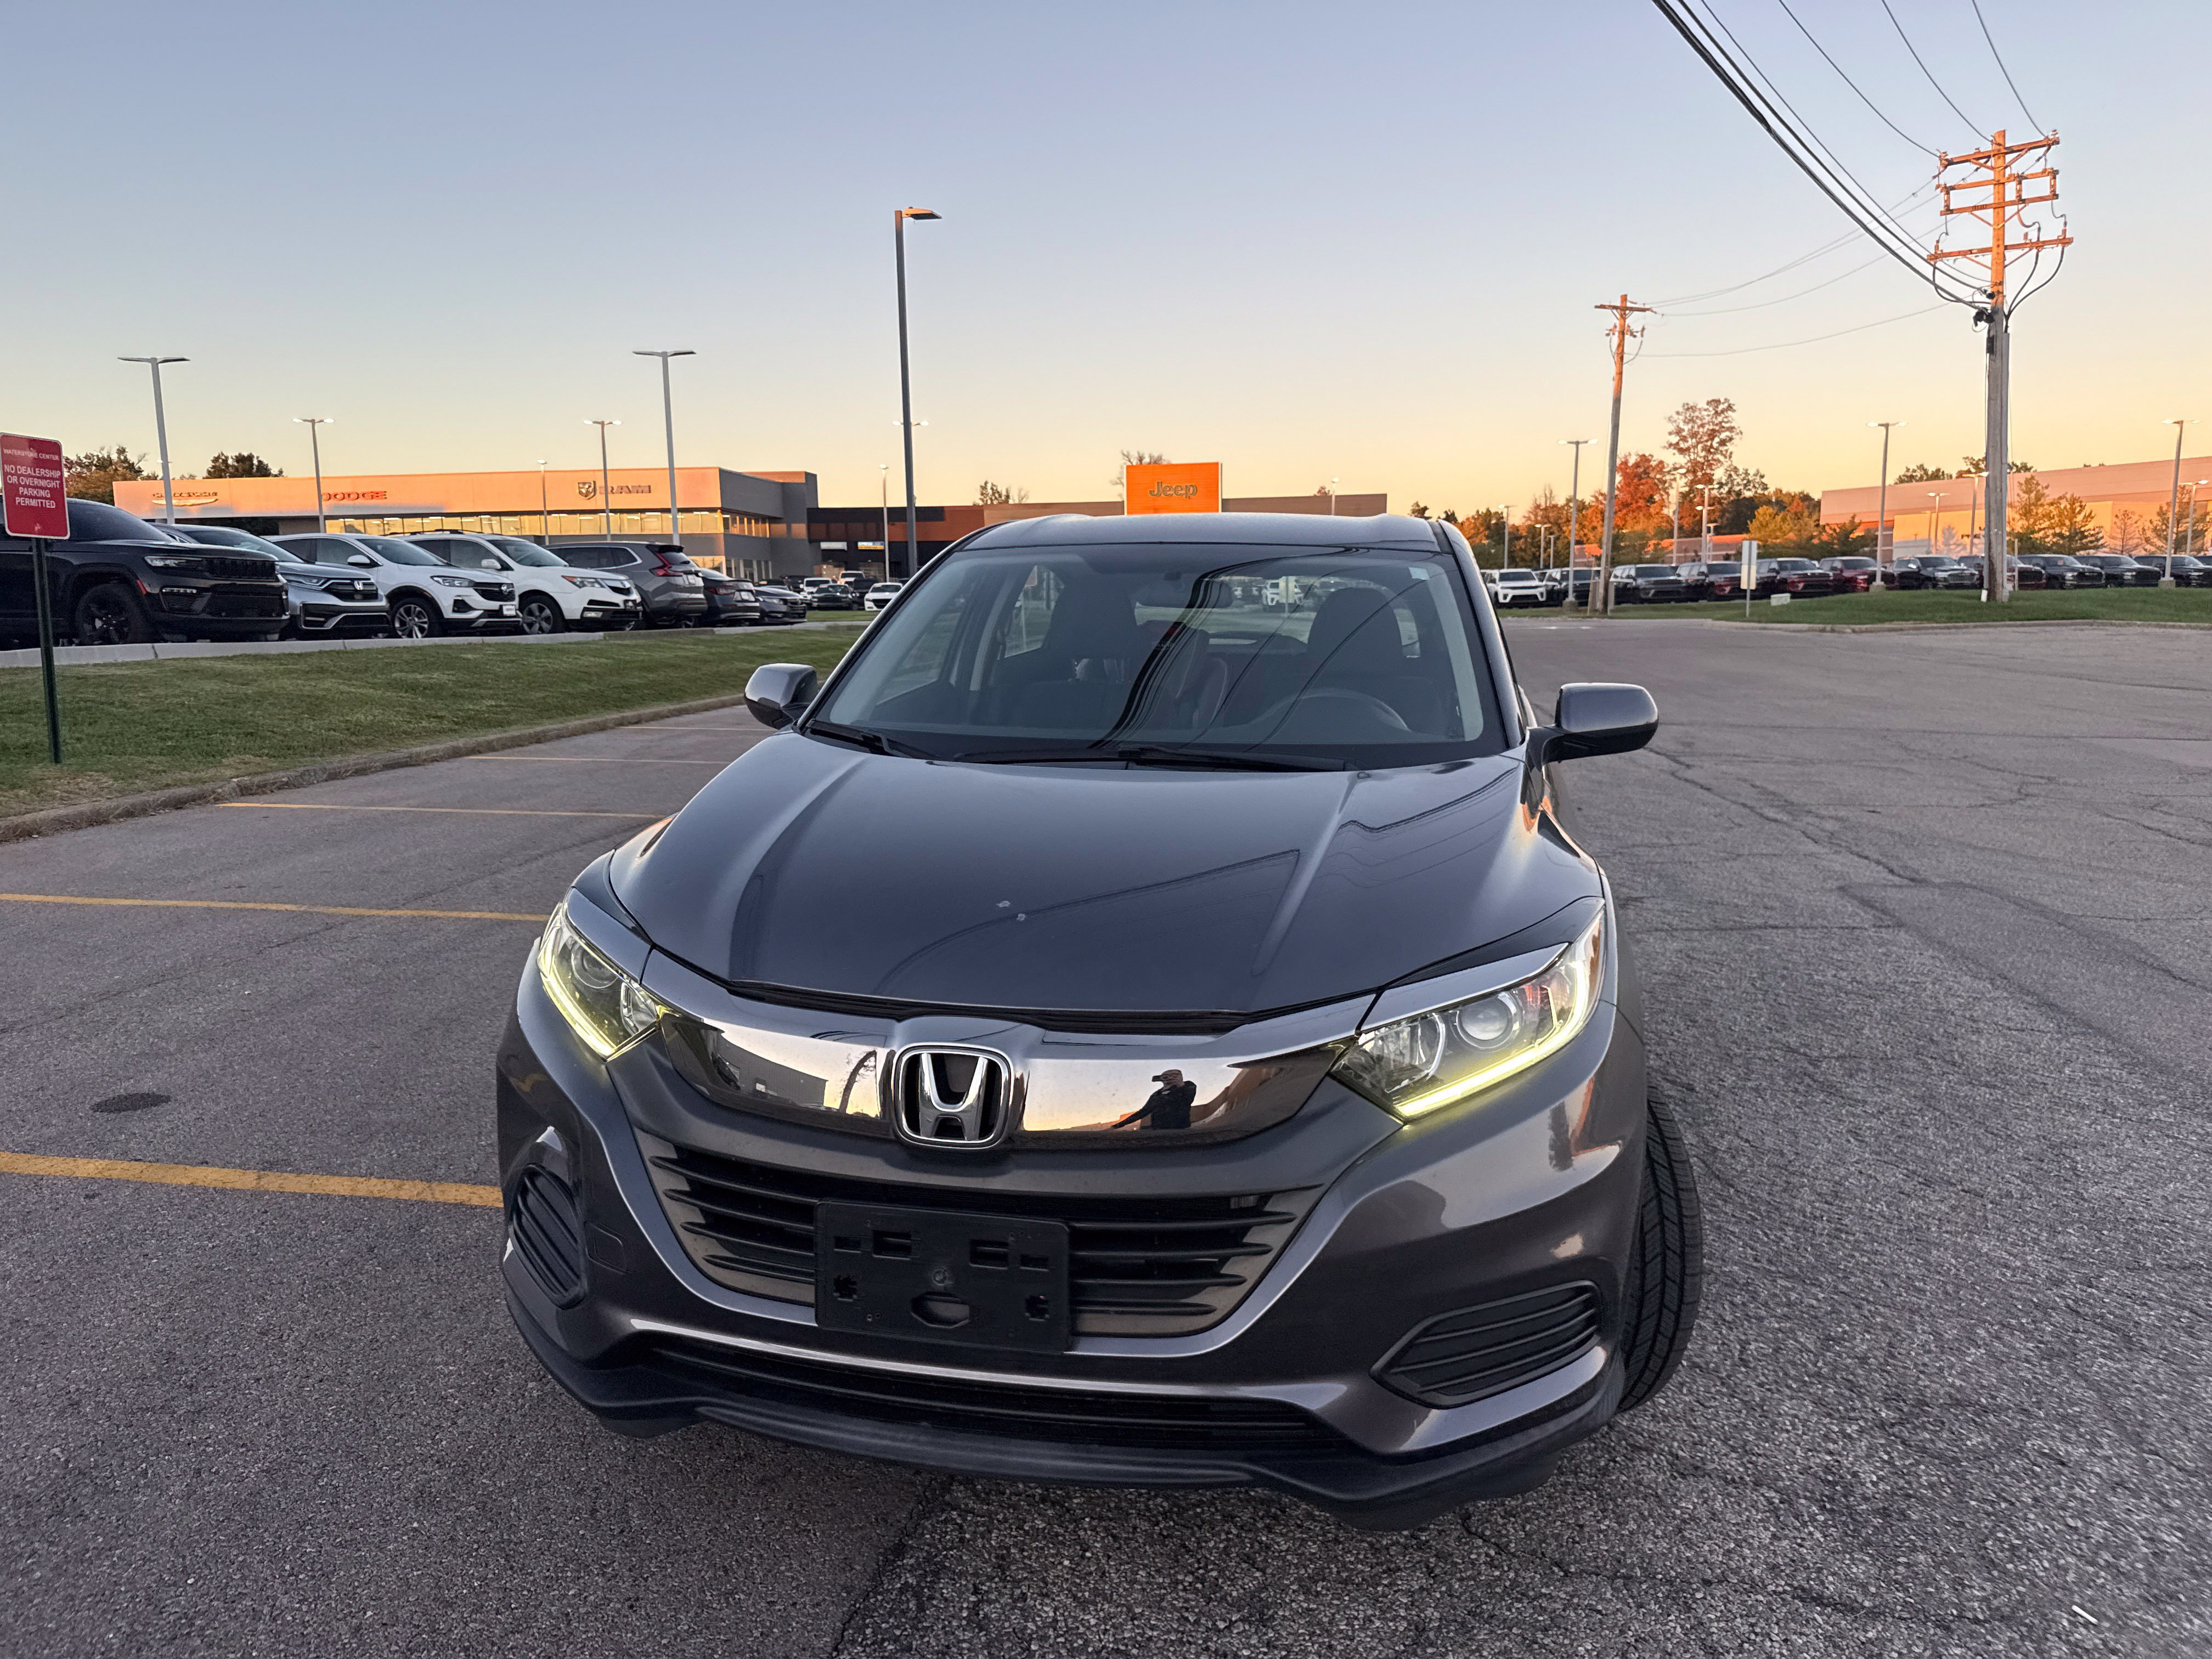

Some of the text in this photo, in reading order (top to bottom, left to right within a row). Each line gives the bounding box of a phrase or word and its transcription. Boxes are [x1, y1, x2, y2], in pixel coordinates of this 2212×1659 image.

[3, 448, 38, 458] WATERSTONE
[4, 464, 61, 478] NO DEALERSHIP
[7, 475, 60, 488] OR OVERNIGHT
[19, 487, 50, 498] PARKING
[599, 485, 651, 494] RAM
[1149, 481, 1198, 499] Jeep
[321, 491, 387, 501] DODGE
[15, 497, 56, 509] PERMITTED
